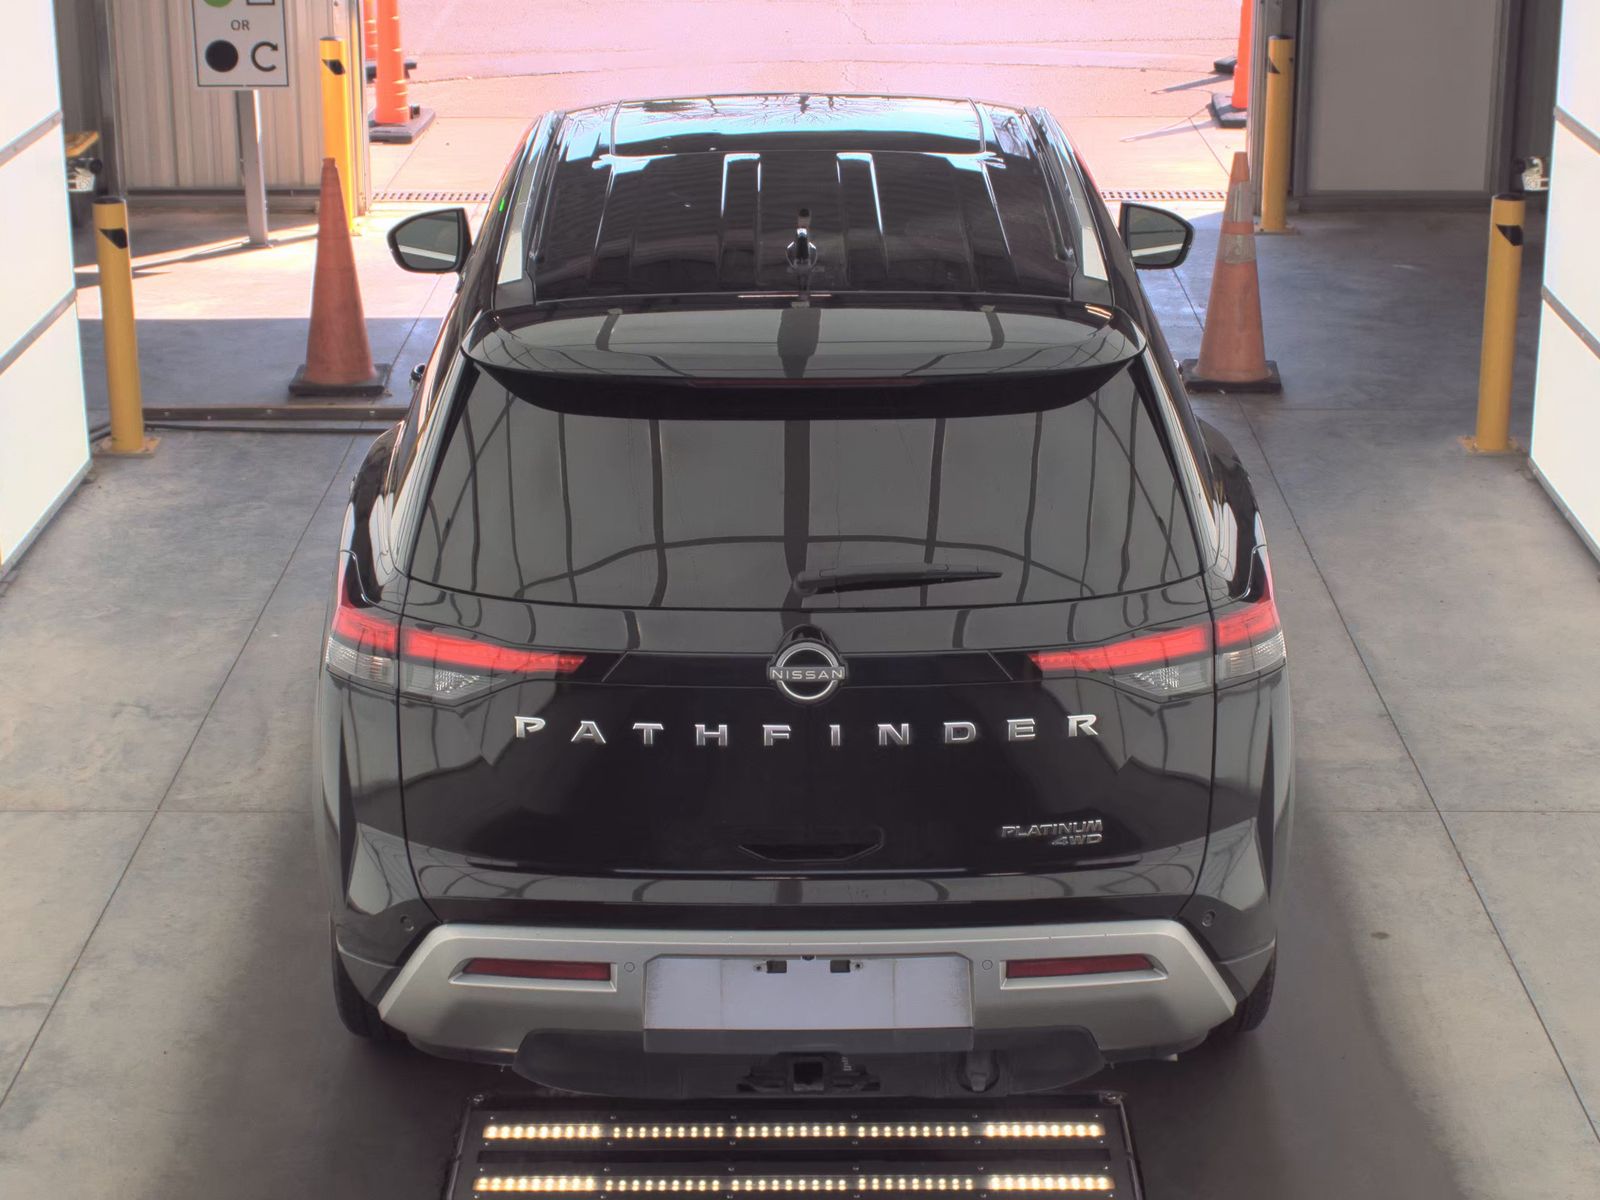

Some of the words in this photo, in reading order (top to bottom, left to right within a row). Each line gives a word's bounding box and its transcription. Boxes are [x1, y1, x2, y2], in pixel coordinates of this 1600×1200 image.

[230, 19, 250, 31] OR
[771, 669, 843, 680] NISSAN
[514, 713, 1099, 747] PATHFINDER
[1001, 819, 1103, 838] PLATINUM
[1051, 833, 1103, 846] 4WD
